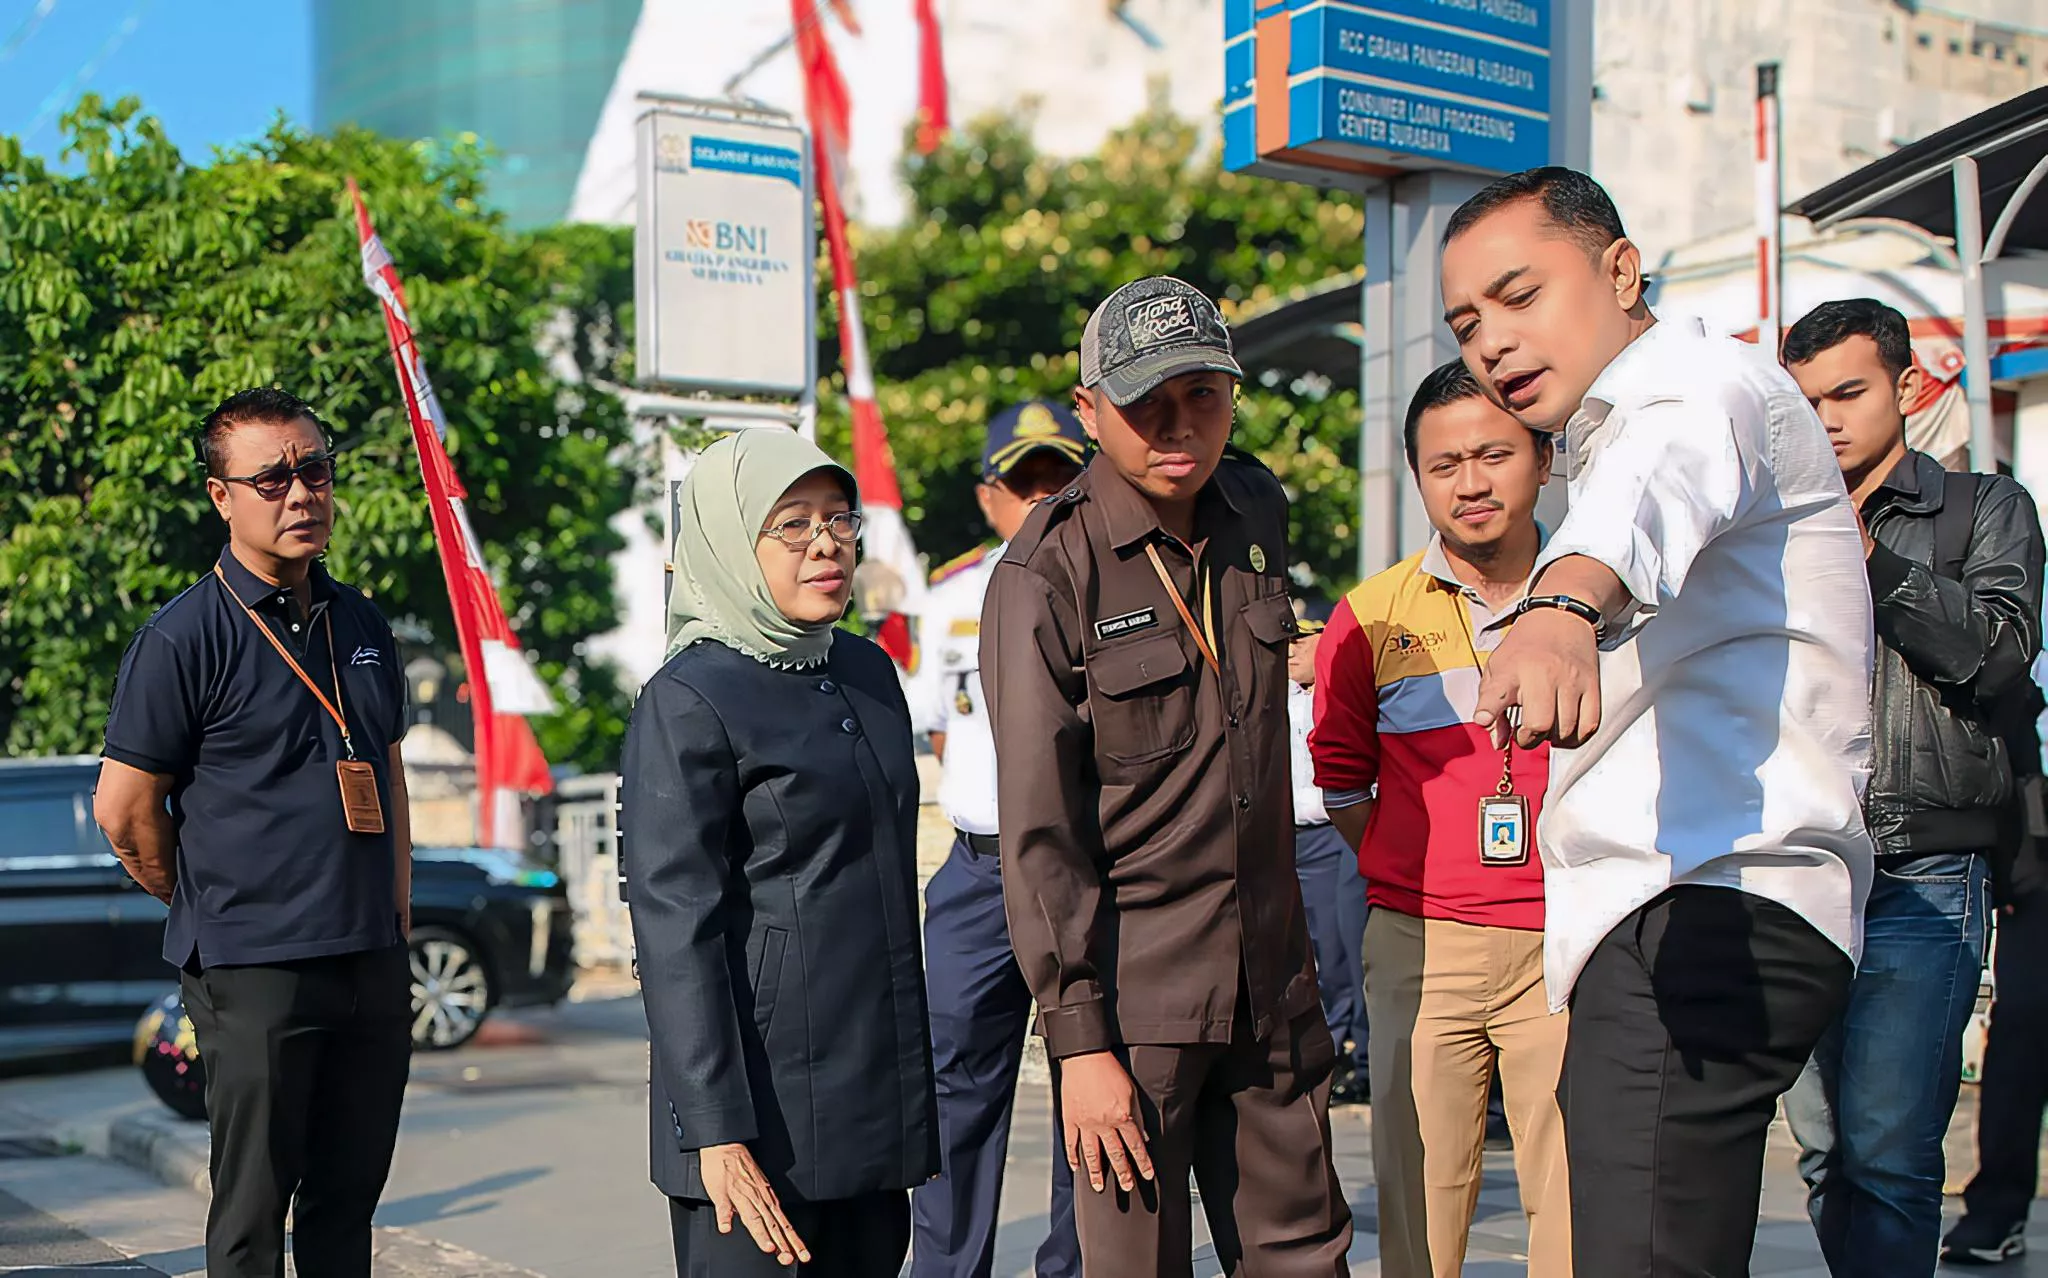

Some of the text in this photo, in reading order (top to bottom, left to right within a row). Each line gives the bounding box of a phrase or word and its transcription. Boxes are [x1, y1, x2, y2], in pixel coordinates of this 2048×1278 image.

[1339, 28, 1535, 91] RCC GRAHA PANGERAN SURABAYA
[1338, 88, 1515, 143] CONSUMER LOAN PROCESSING
[1338, 113, 1451, 152] CENTER SURABAYA
[715, 221, 767, 255] BNI
[1130, 296, 1186, 329] Hard
[1143, 309, 1190, 334] Rock
